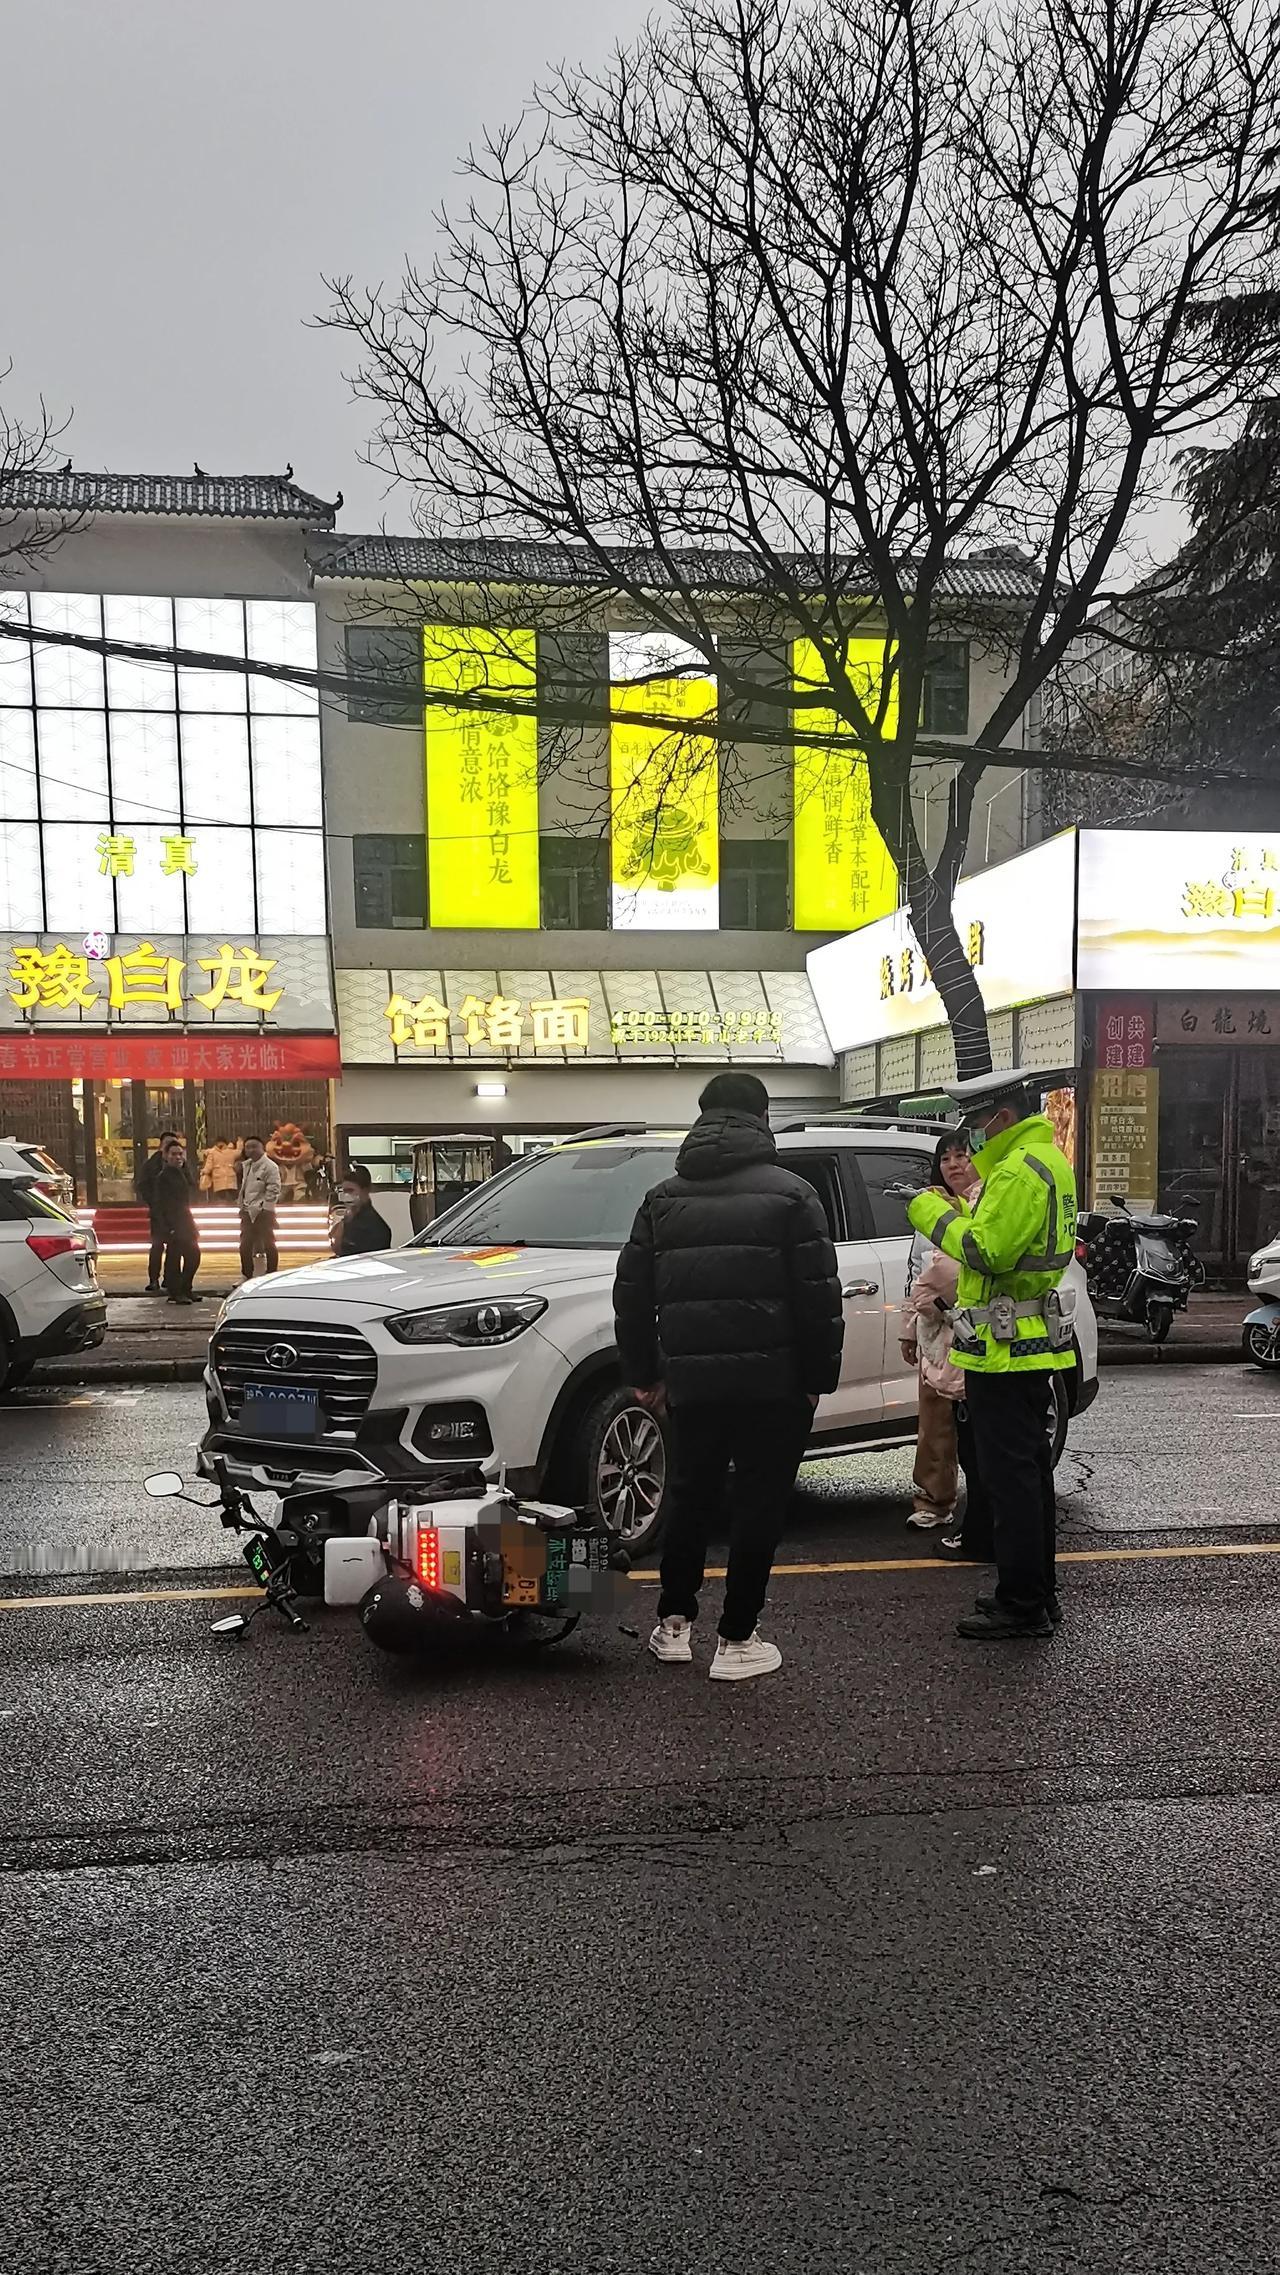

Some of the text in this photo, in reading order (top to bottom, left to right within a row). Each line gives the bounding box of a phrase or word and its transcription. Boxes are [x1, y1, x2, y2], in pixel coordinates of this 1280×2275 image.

[486, 742, 513, 884] 饸饹豫白龙
[95, 833, 198, 878] 清真
[6, 941, 285, 1012] 豫白龙
[387, 993, 590, 1047] 饸饹面
[611, 1011, 783, 1027] 400-010-9988
[1102, 1074, 1147, 1098] 招聘
